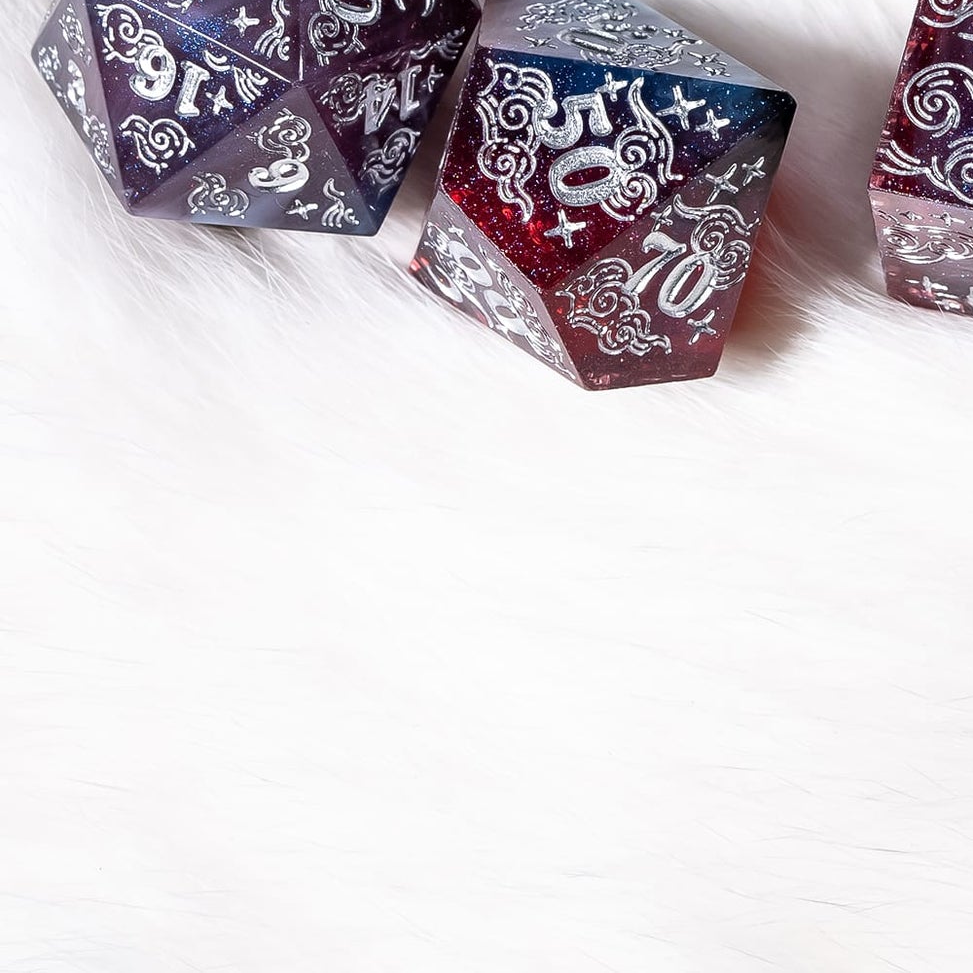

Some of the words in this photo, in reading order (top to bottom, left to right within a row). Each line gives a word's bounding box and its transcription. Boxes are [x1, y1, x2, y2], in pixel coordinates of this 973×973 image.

[129, 44, 211, 117] 16
[364, 65, 422, 135] 14
[535, 92, 620, 207] 50
[623, 232, 718, 317] 70
